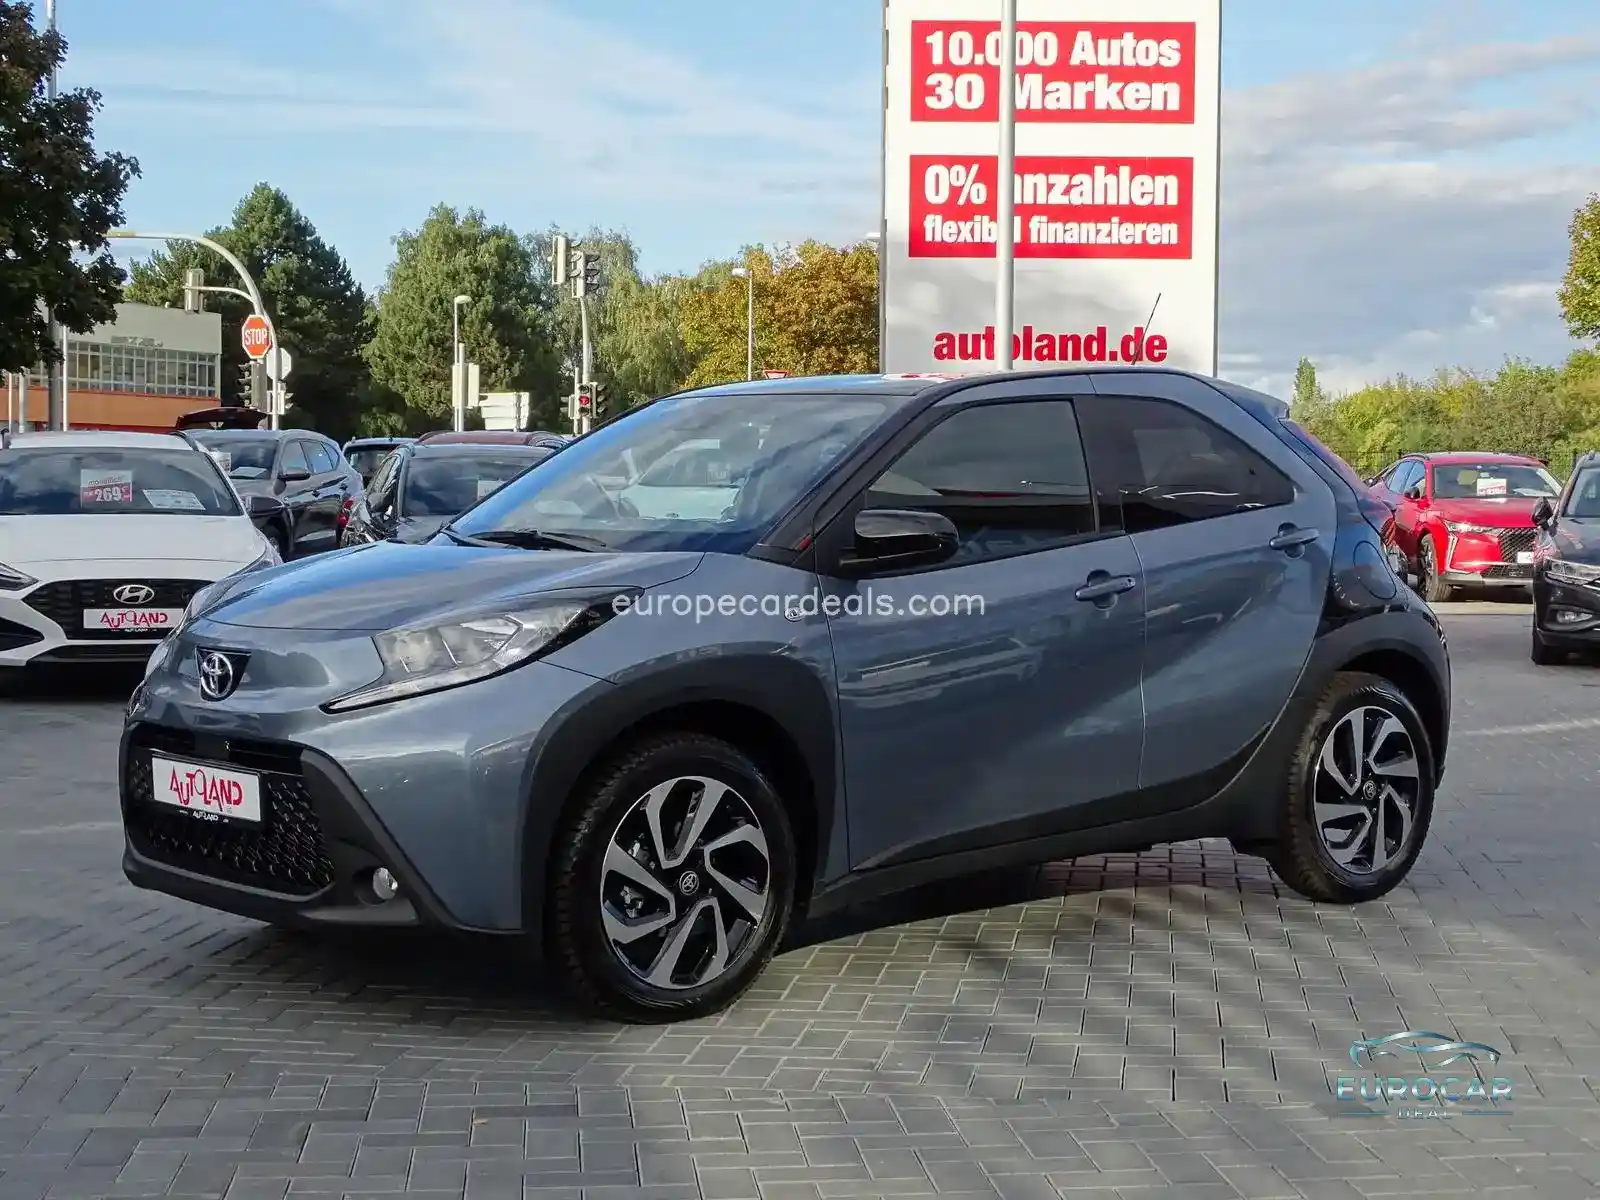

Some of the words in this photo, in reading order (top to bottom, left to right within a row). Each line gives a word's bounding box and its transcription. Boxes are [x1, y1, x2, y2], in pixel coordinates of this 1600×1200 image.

[925, 30, 1058, 67] 10.000
[1070, 31, 1182, 68] Autos
[925, 73, 985, 110] 30
[1015, 73, 1180, 111] Marken
[924, 163, 987, 206] 0%
[924, 214, 1021, 244] flexibl
[1029, 216, 1178, 245] finanzieren
[245, 328, 268, 345] STOP
[94, 486, 122, 502] 269
[100, 610, 169, 628] AUTOLAND
[169, 765, 243, 812] AUTOLAND
